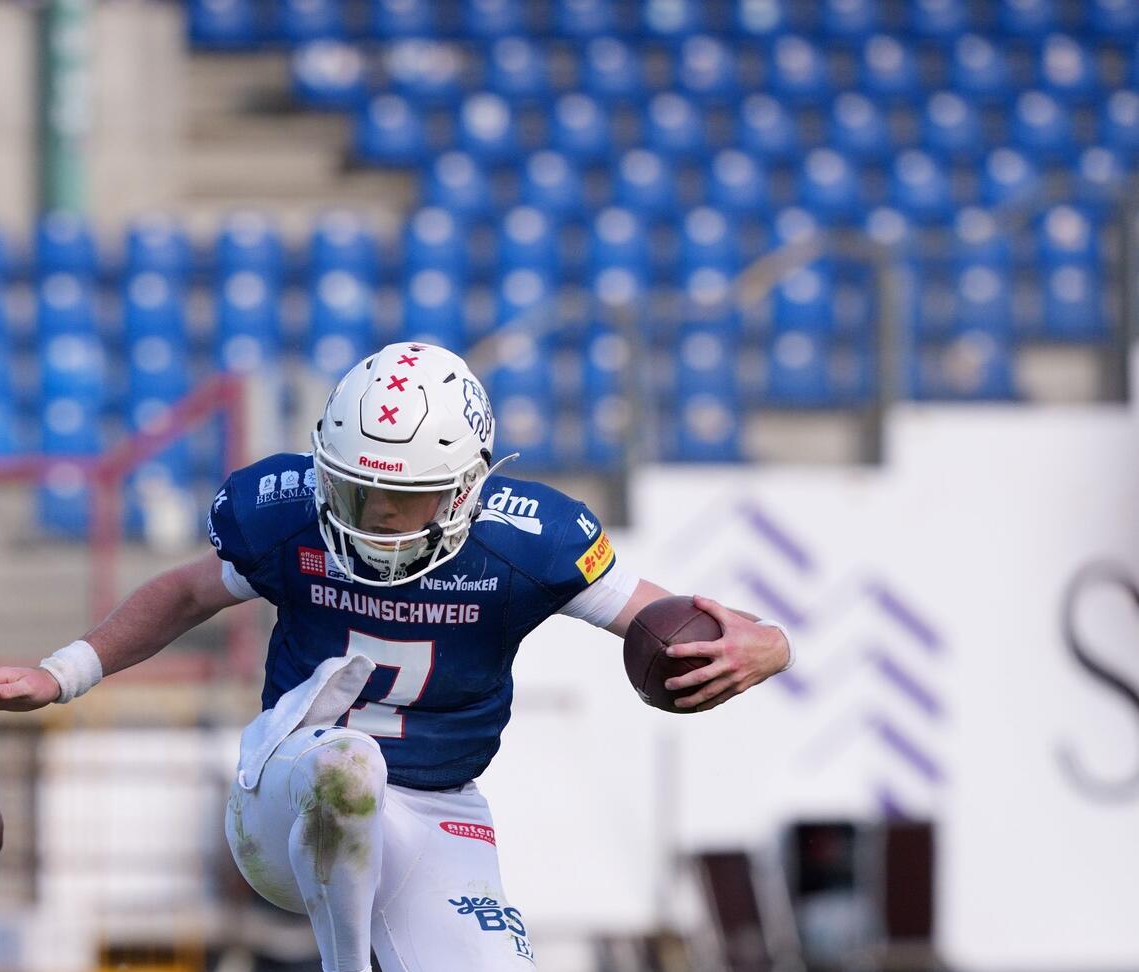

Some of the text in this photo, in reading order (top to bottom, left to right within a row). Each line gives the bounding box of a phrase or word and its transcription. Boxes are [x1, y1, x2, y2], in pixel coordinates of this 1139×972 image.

[359, 456, 403, 472] Riddell
[487, 486, 539, 517] dm
[310, 583, 480, 624] BRAUNSCHWEIG
[346, 628, 435, 739] 7
[475, 907, 526, 937] BS
